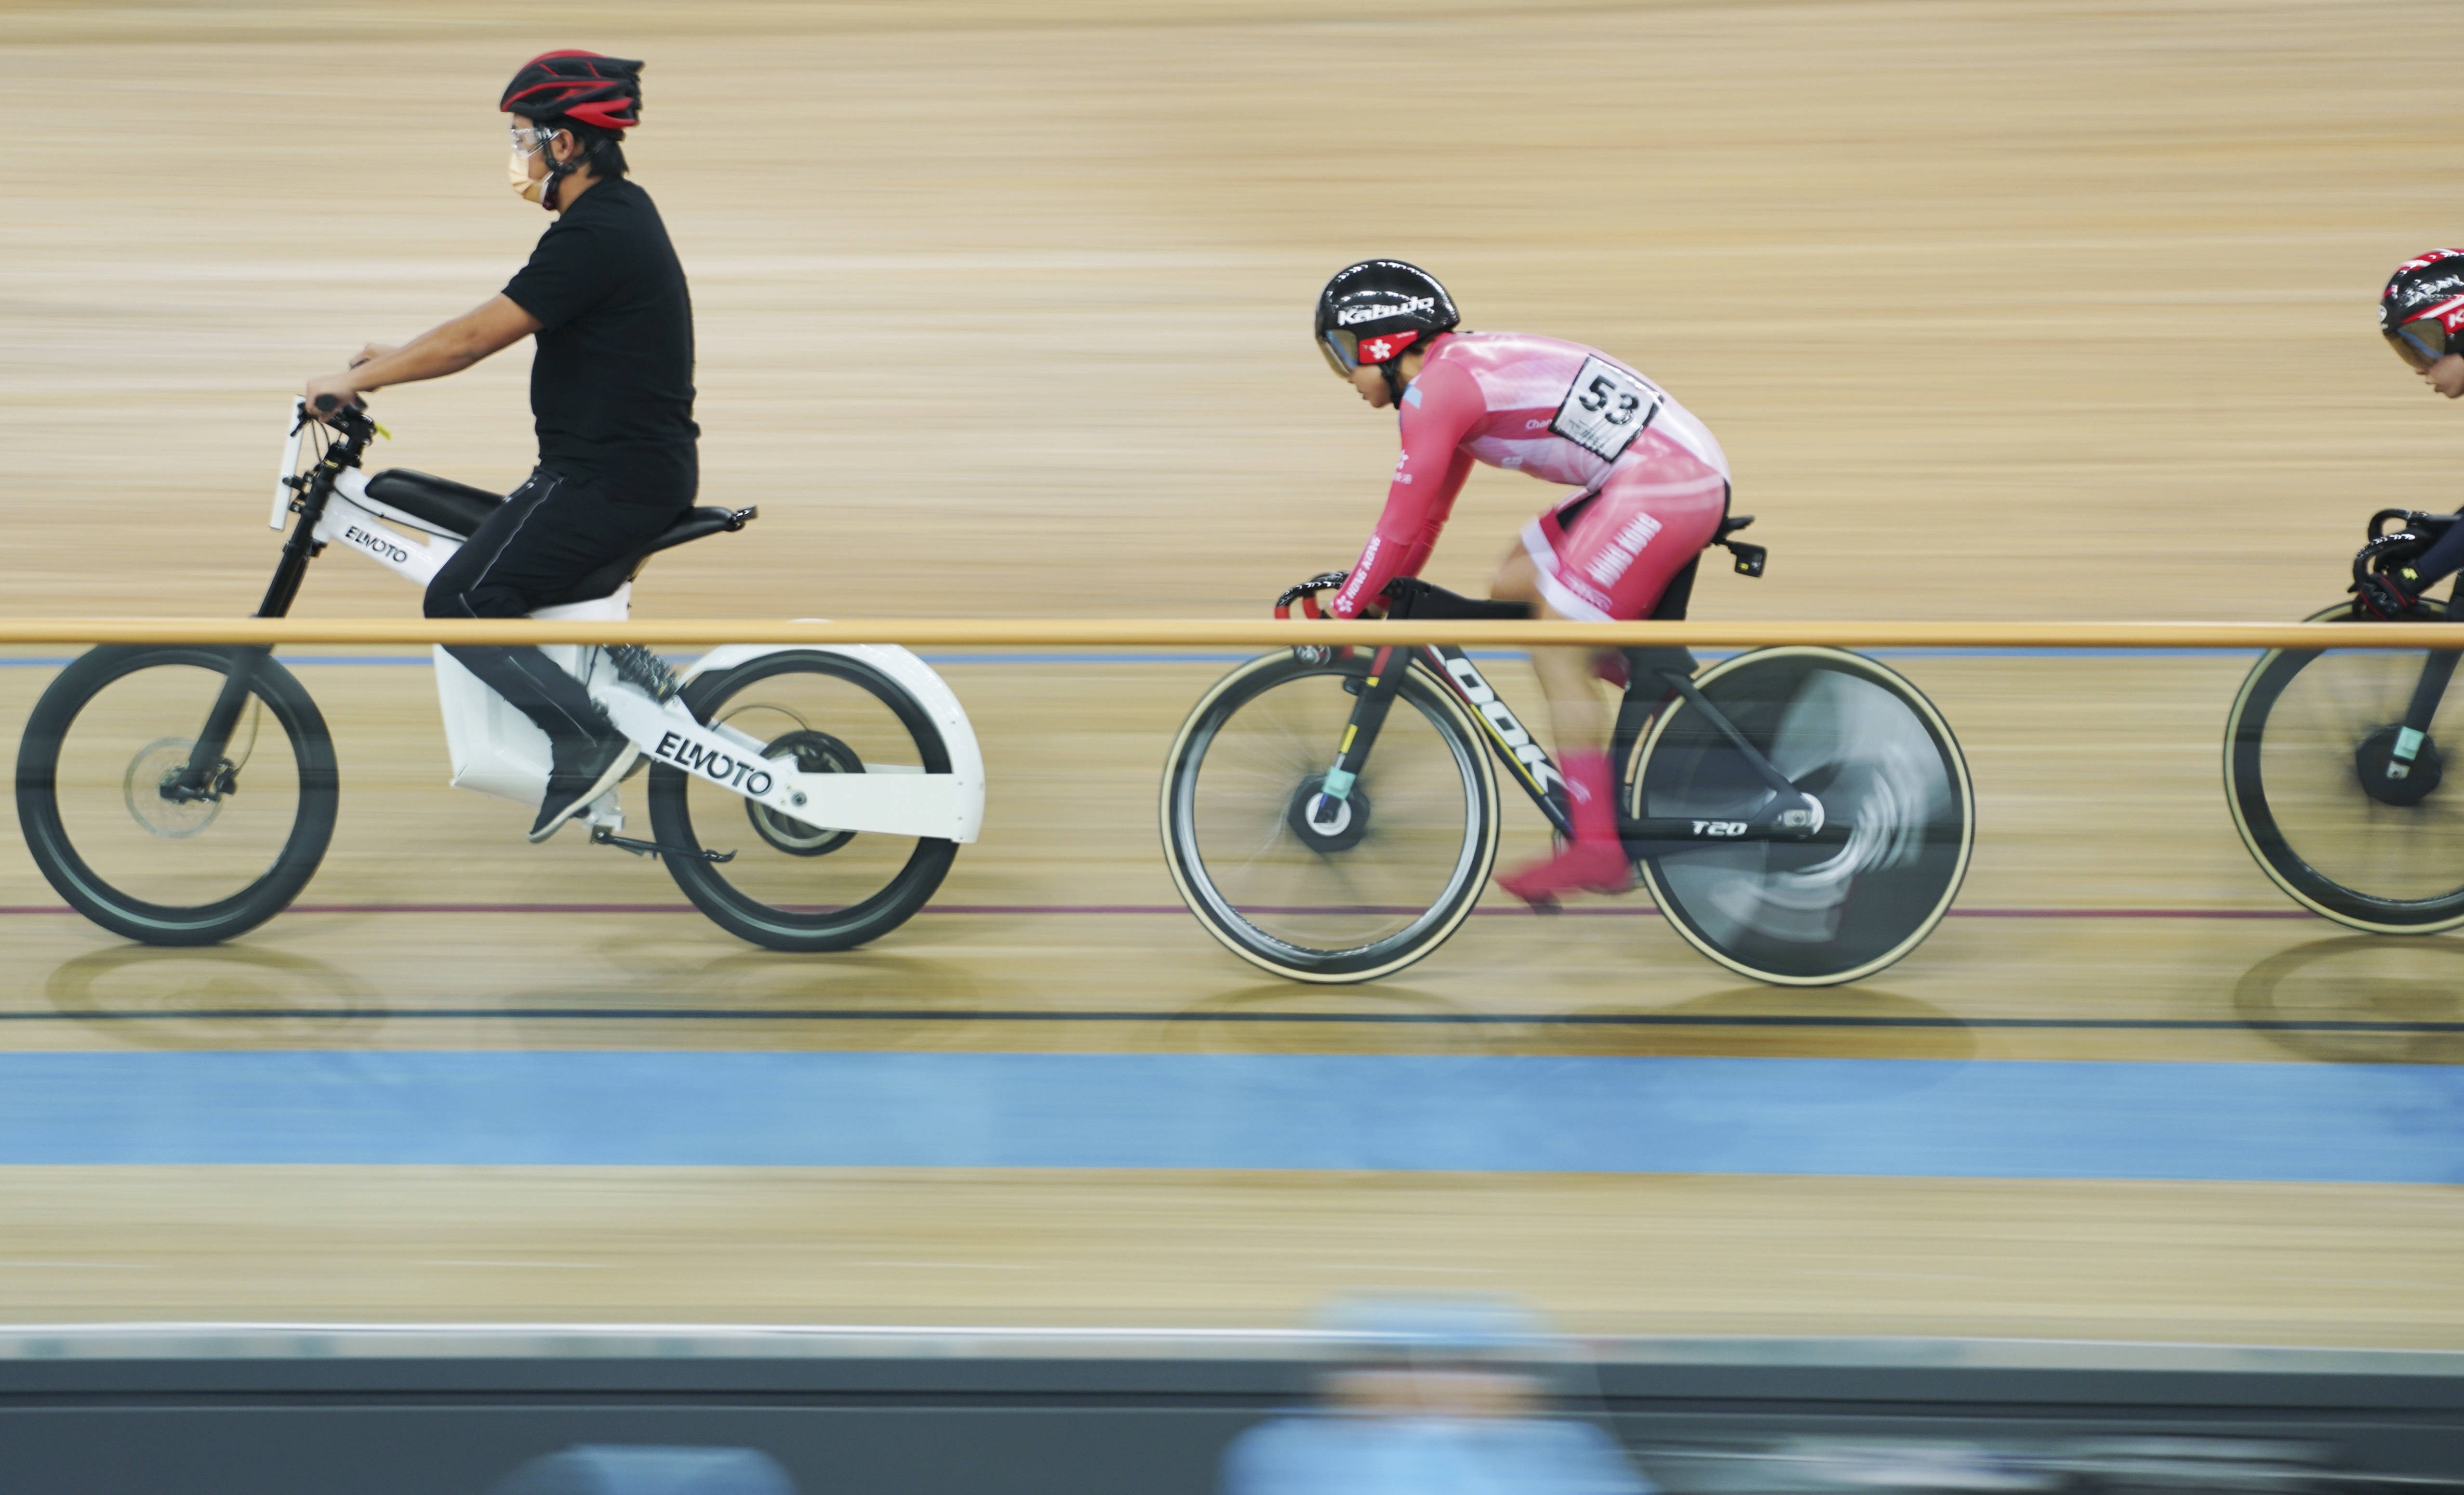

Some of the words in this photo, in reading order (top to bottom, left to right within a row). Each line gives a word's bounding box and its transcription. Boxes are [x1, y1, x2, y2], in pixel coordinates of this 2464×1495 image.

[1578, 374, 1639, 425] 53
[345, 525, 408, 562] ELMOTO
[1346, 568, 1368, 600] HONG
[1361, 534, 1381, 571] KONG
[1427, 644, 1569, 794] OOK
[655, 730, 774, 796] ELMOTO
